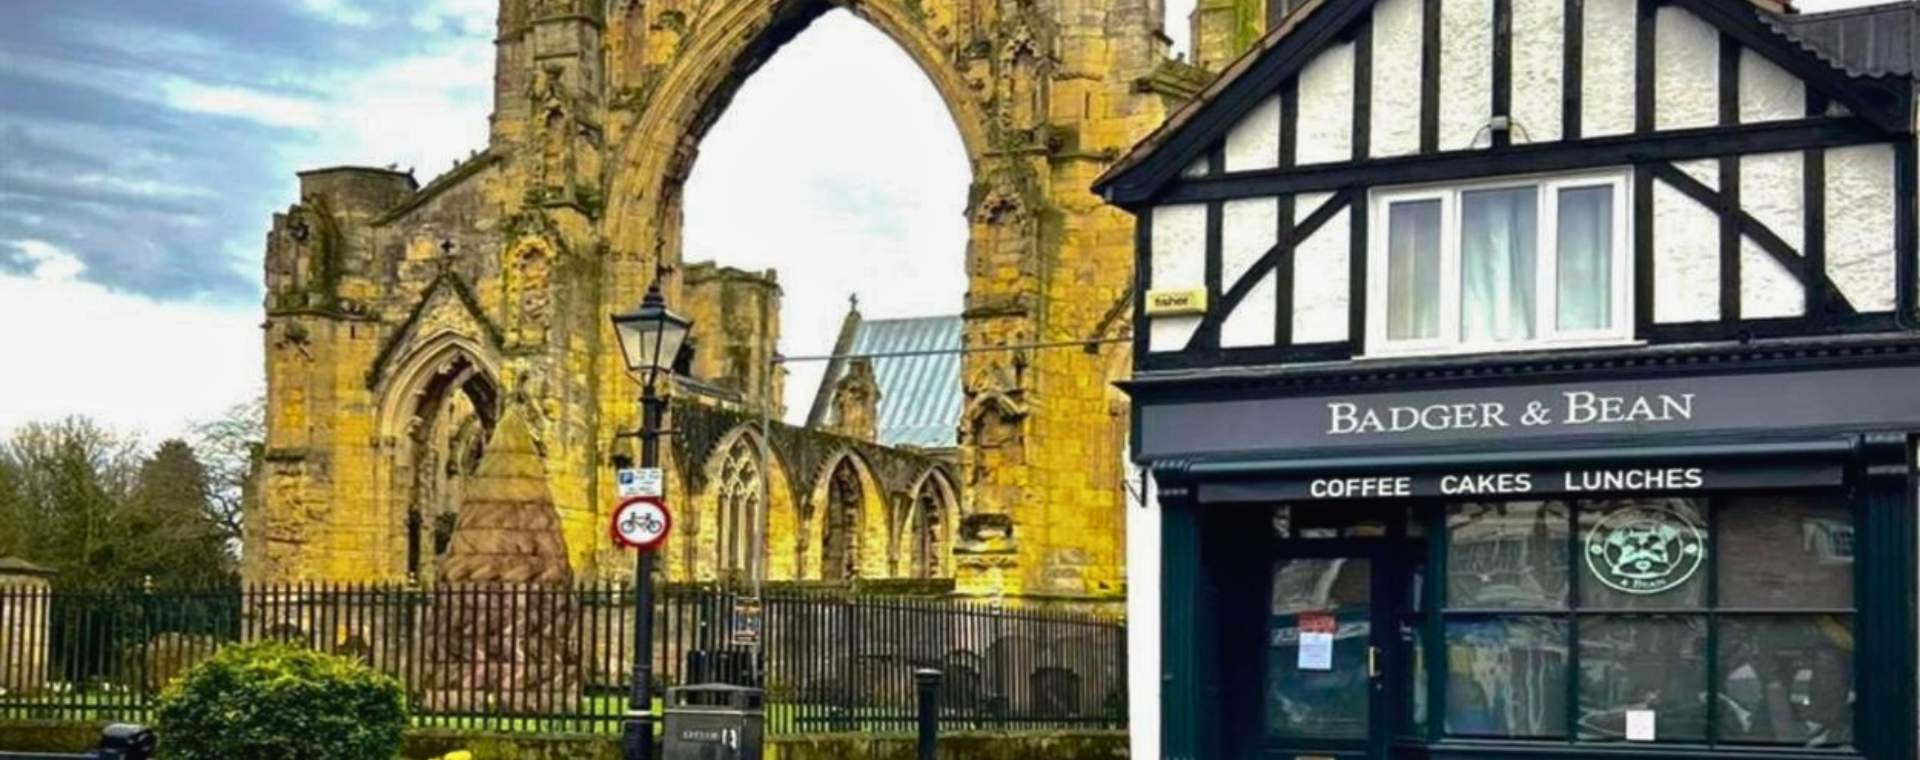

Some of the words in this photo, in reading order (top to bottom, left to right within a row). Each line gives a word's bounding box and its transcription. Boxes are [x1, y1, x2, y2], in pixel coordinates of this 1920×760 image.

[1327, 403, 1508, 434] BADGER
[1520, 401, 1551, 426] &
[1562, 391, 1695, 424] BEAN
[1311, 478, 1411, 498] COFFEE
[1440, 473, 1532, 495] CAKES
[1565, 468, 1702, 491] LUNCHES
